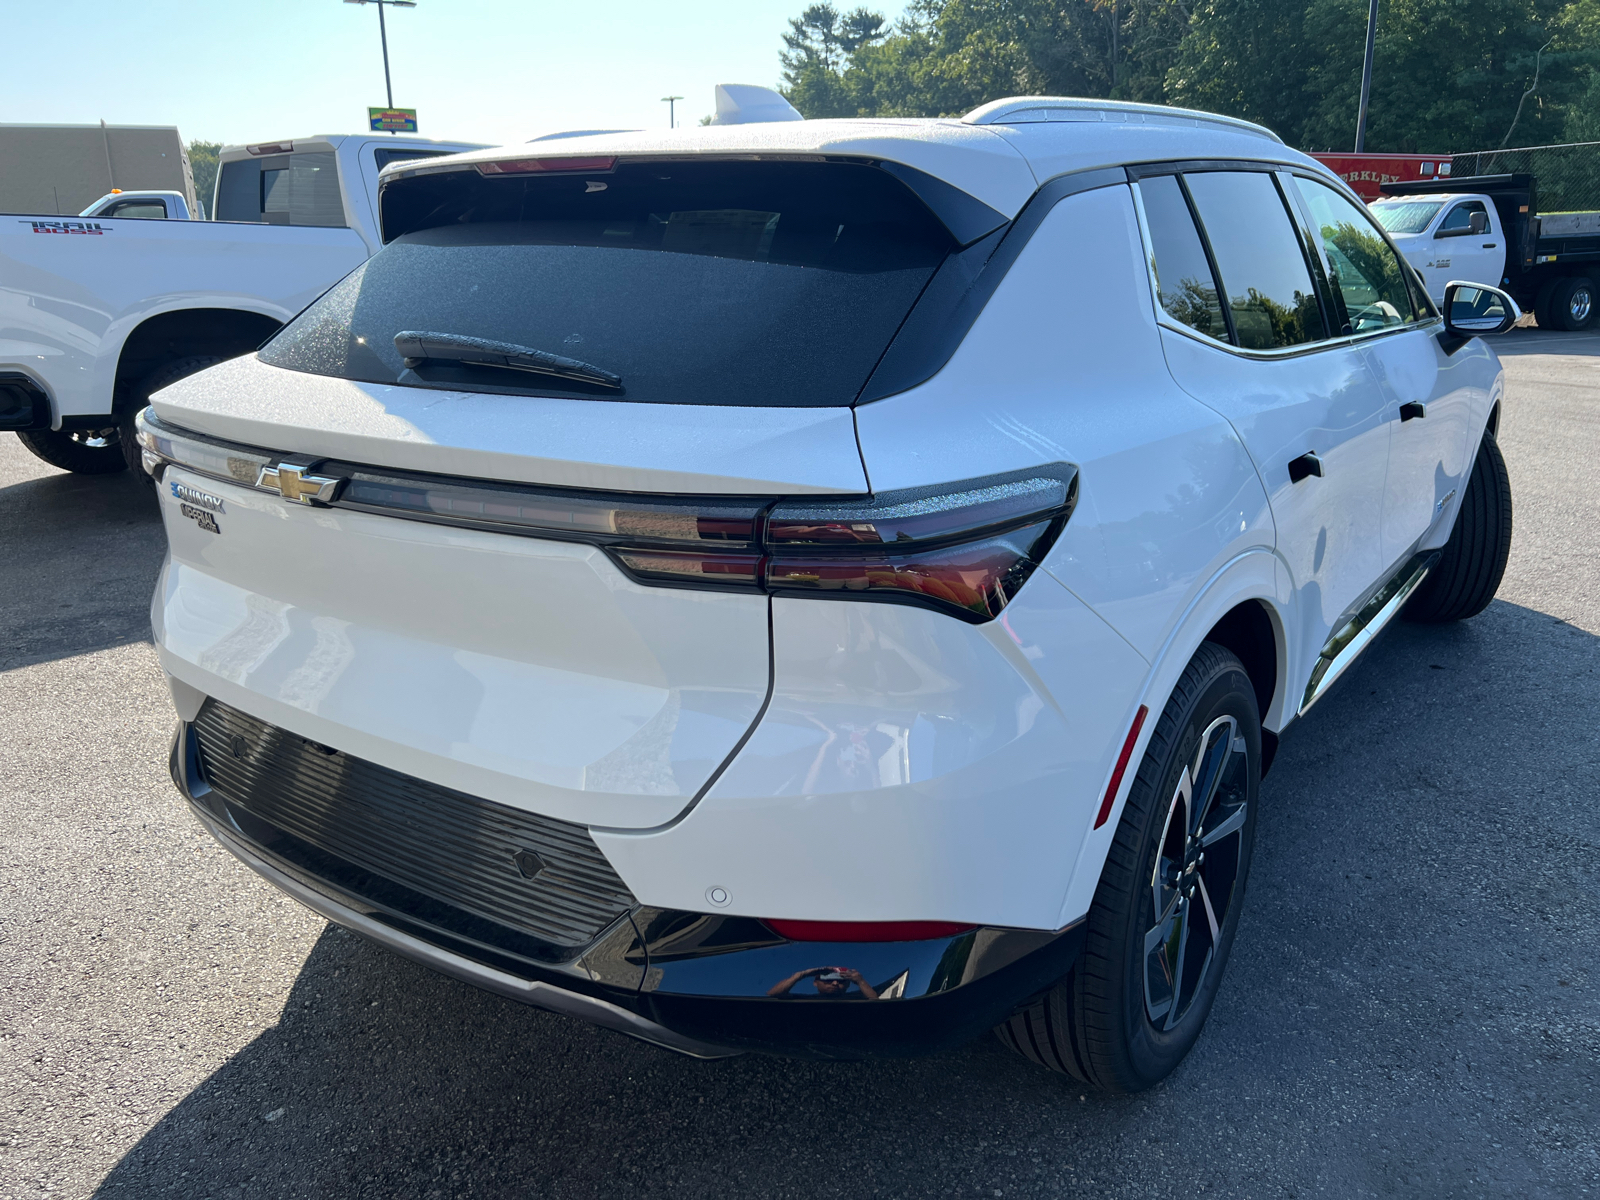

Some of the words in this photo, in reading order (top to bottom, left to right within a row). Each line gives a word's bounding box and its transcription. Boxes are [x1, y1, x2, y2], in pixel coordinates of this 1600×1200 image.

[1339, 171, 1400, 183] ERKLEY
[18, 221, 113, 230] TRAIL
[170, 481, 226, 515] EQUINOX
